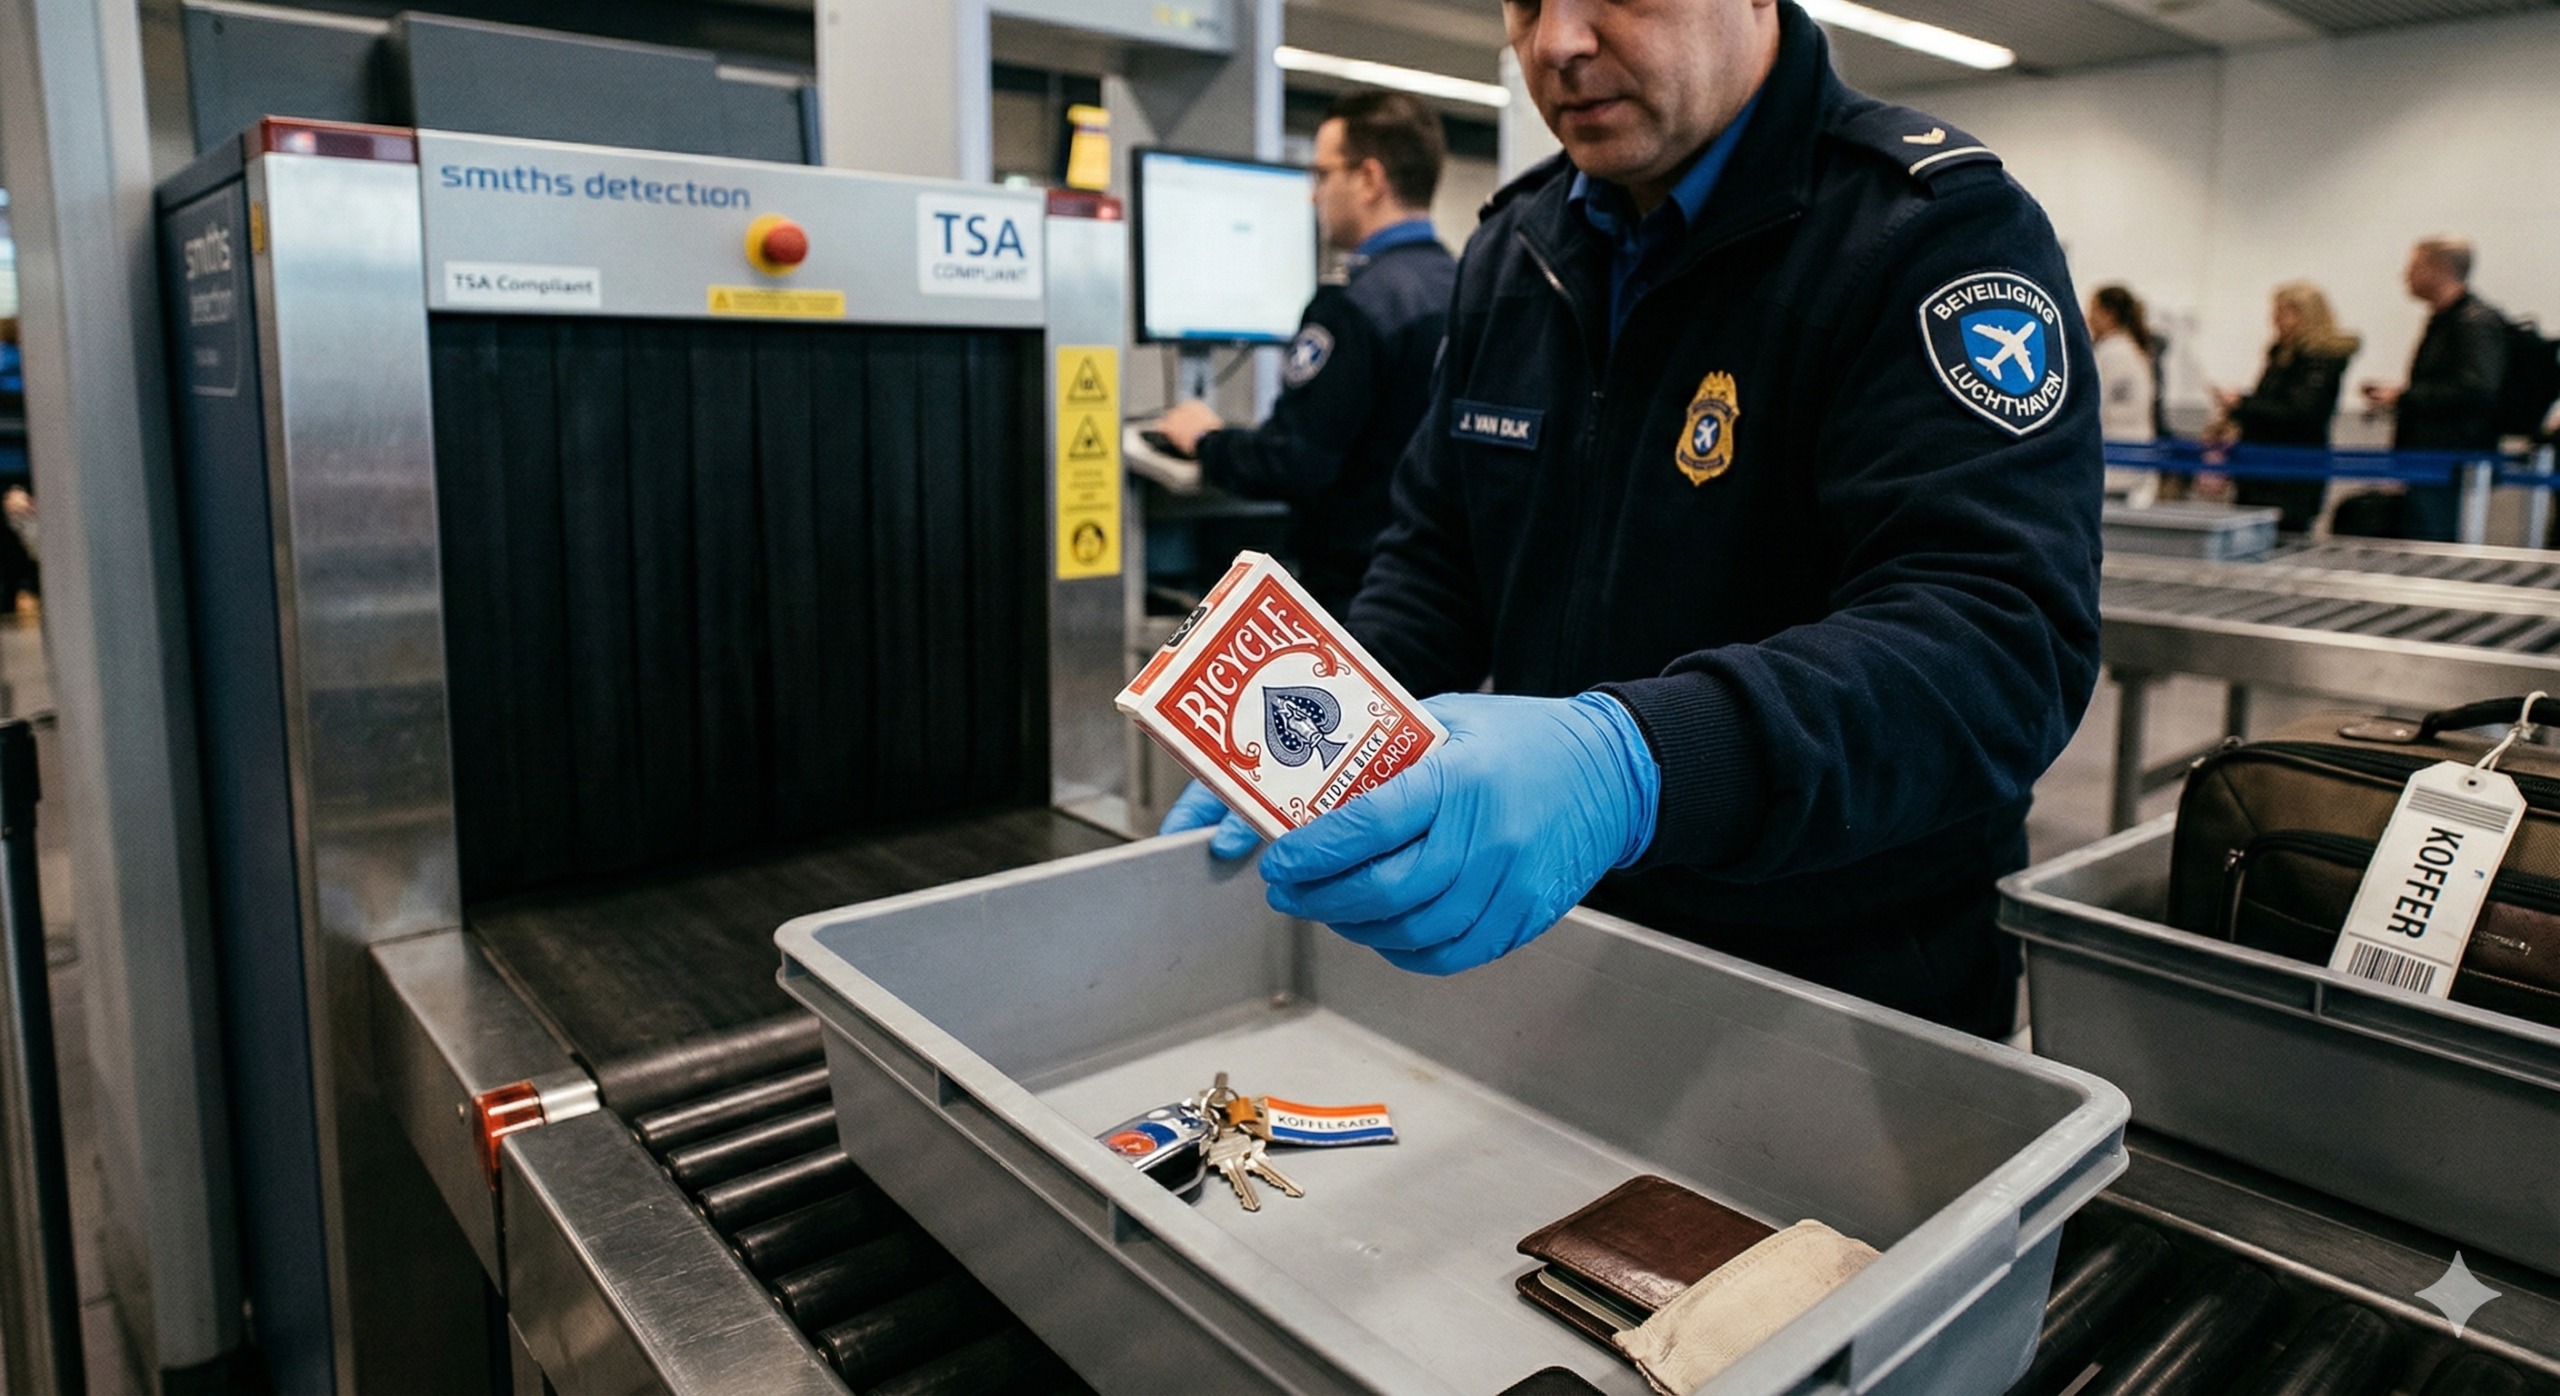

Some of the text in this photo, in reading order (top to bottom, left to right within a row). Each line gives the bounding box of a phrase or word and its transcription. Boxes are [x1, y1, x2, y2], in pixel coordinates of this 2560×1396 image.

[441, 164, 751, 211] smiths detection
[933, 211, 1025, 258] TSA
[453, 272, 593, 295] TSA Compliant
[1933, 282, 2055, 326] BEVEILIGING
[1949, 362, 2063, 417] LUCHTHAVEN
[1459, 412, 1472, 431] J.
[1474, 413, 1500, 436] VAN
[1175, 596, 1320, 753] BICYCLE
[1319, 733, 1384, 810] RIDER BACK
[1373, 725, 1418, 779] CARDS
[2386, 827, 2465, 939] KOFFER
